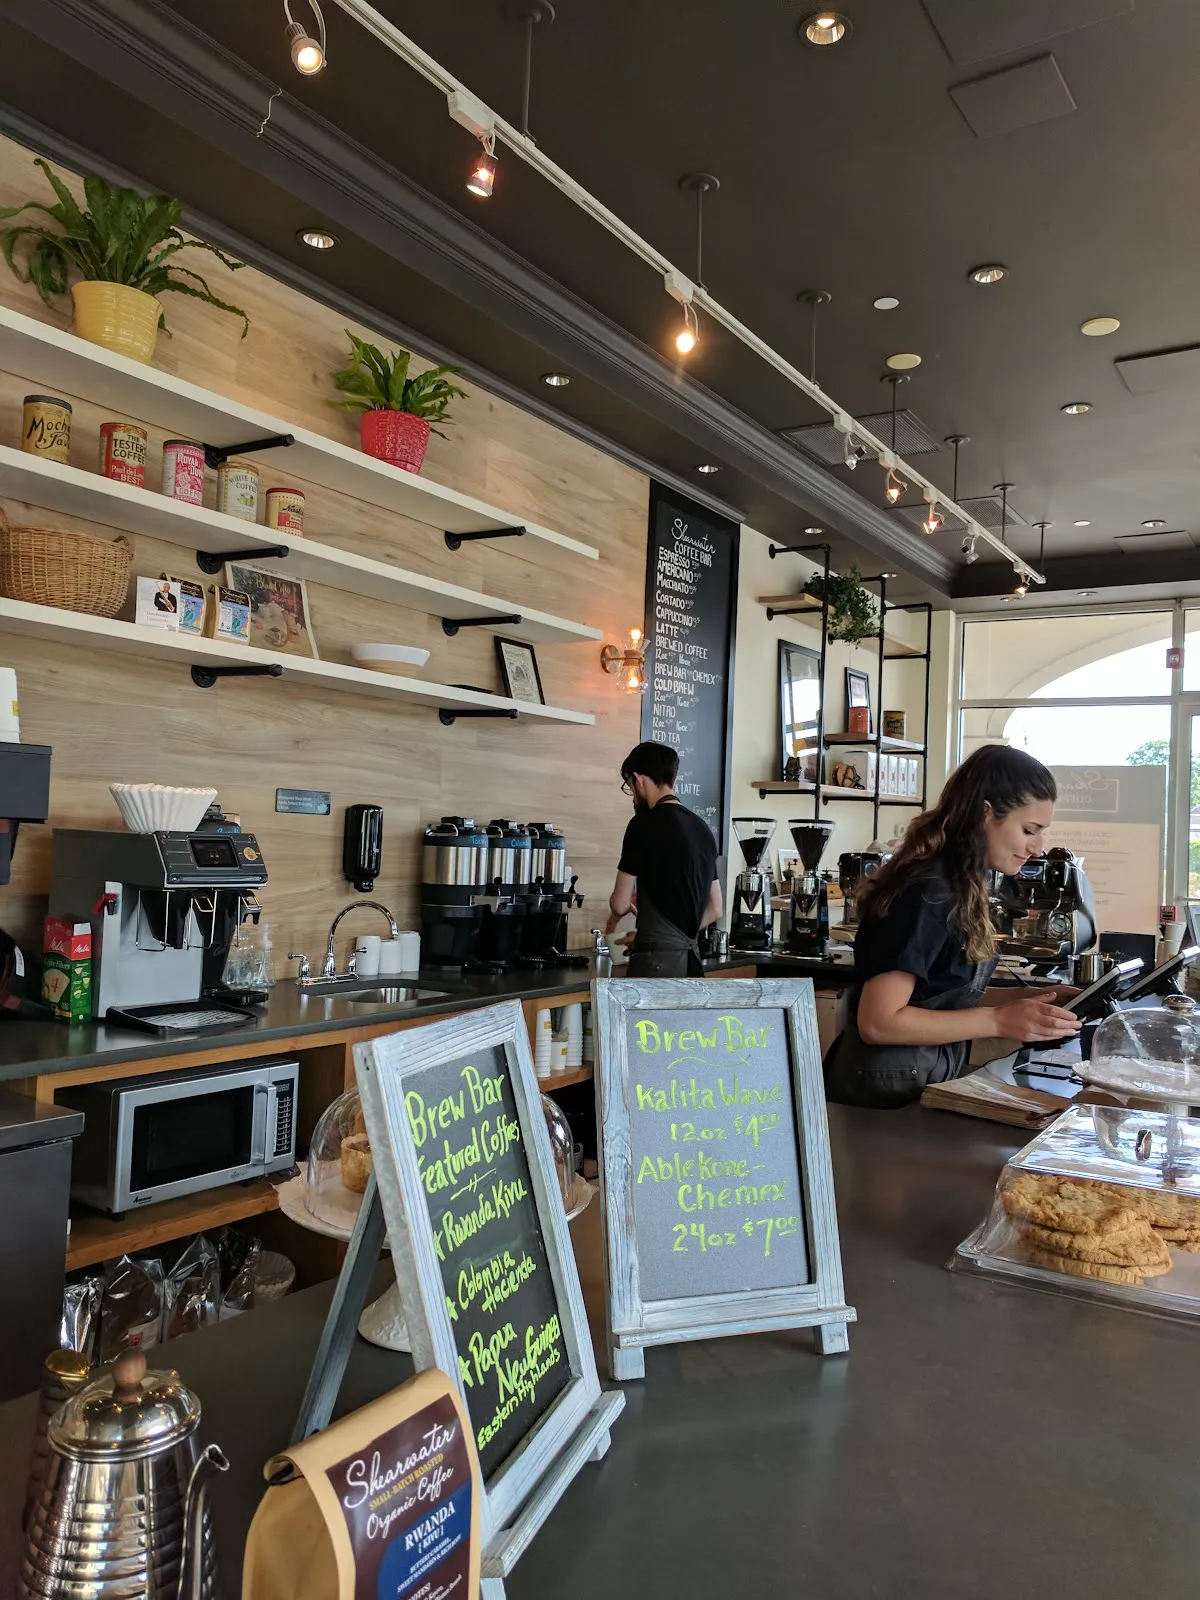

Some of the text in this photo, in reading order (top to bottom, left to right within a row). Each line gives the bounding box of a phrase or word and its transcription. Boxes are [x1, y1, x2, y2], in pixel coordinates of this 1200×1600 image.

[127, 434, 140, 443] THE
[120, 474, 142, 486] BEST
[671, 518, 716, 554] Shearwater
[658, 545, 690, 569] ESPRESSO
[674, 540, 699, 561] COFFEE
[699, 550, 712, 568] BAR
[656, 559, 694, 584] AMERICANO
[656, 571, 690, 595] MACCHIATO
[655, 589, 686, 610] CORTADO
[655, 605, 693, 627] CAPPUCCINO
[655, 620, 680, 639] LATTE
[655, 634, 684, 653] BREWED
[684, 642, 709, 660] COFFEE
[653, 676, 695, 696] COLD BREW
[654, 661, 674, 677] BREW
[673, 665, 687, 681] BAR
[692, 669, 717, 686] CHEMEX
[652, 703, 677, 719] NITRO
[667, 731, 681, 744] TEA
[680, 783, 701, 797] LATTE
[634, 1015, 775, 1054] Brew Bar
[403, 1065, 505, 1148] Brew Bar
[636, 1075, 783, 1113] Kalita Wave
[670, 1121, 727, 1143] 12oz
[636, 1154, 695, 1184] Able
[677, 1180, 787, 1213] Chemex
[442, 1192, 496, 1252] Rwanda
[672, 1222, 737, 1252] 24oz
[457, 1250, 515, 1311] Colombia
[481, 1250, 537, 1314] Hacienda
[468, 1321, 518, 1386] Papua
[498, 1314, 561, 1404] New Guinea
[477, 1343, 561, 1451] Eastern Highlands
[343, 1422, 456, 1509] Shearwater
[368, 1453, 444, 1511] SMALL-BATCH ROASTED
[366, 1465, 455, 1540] Organic Coffee
[404, 1500, 456, 1551] RWANDA
[422, 1527, 441, 1549] KIVU
